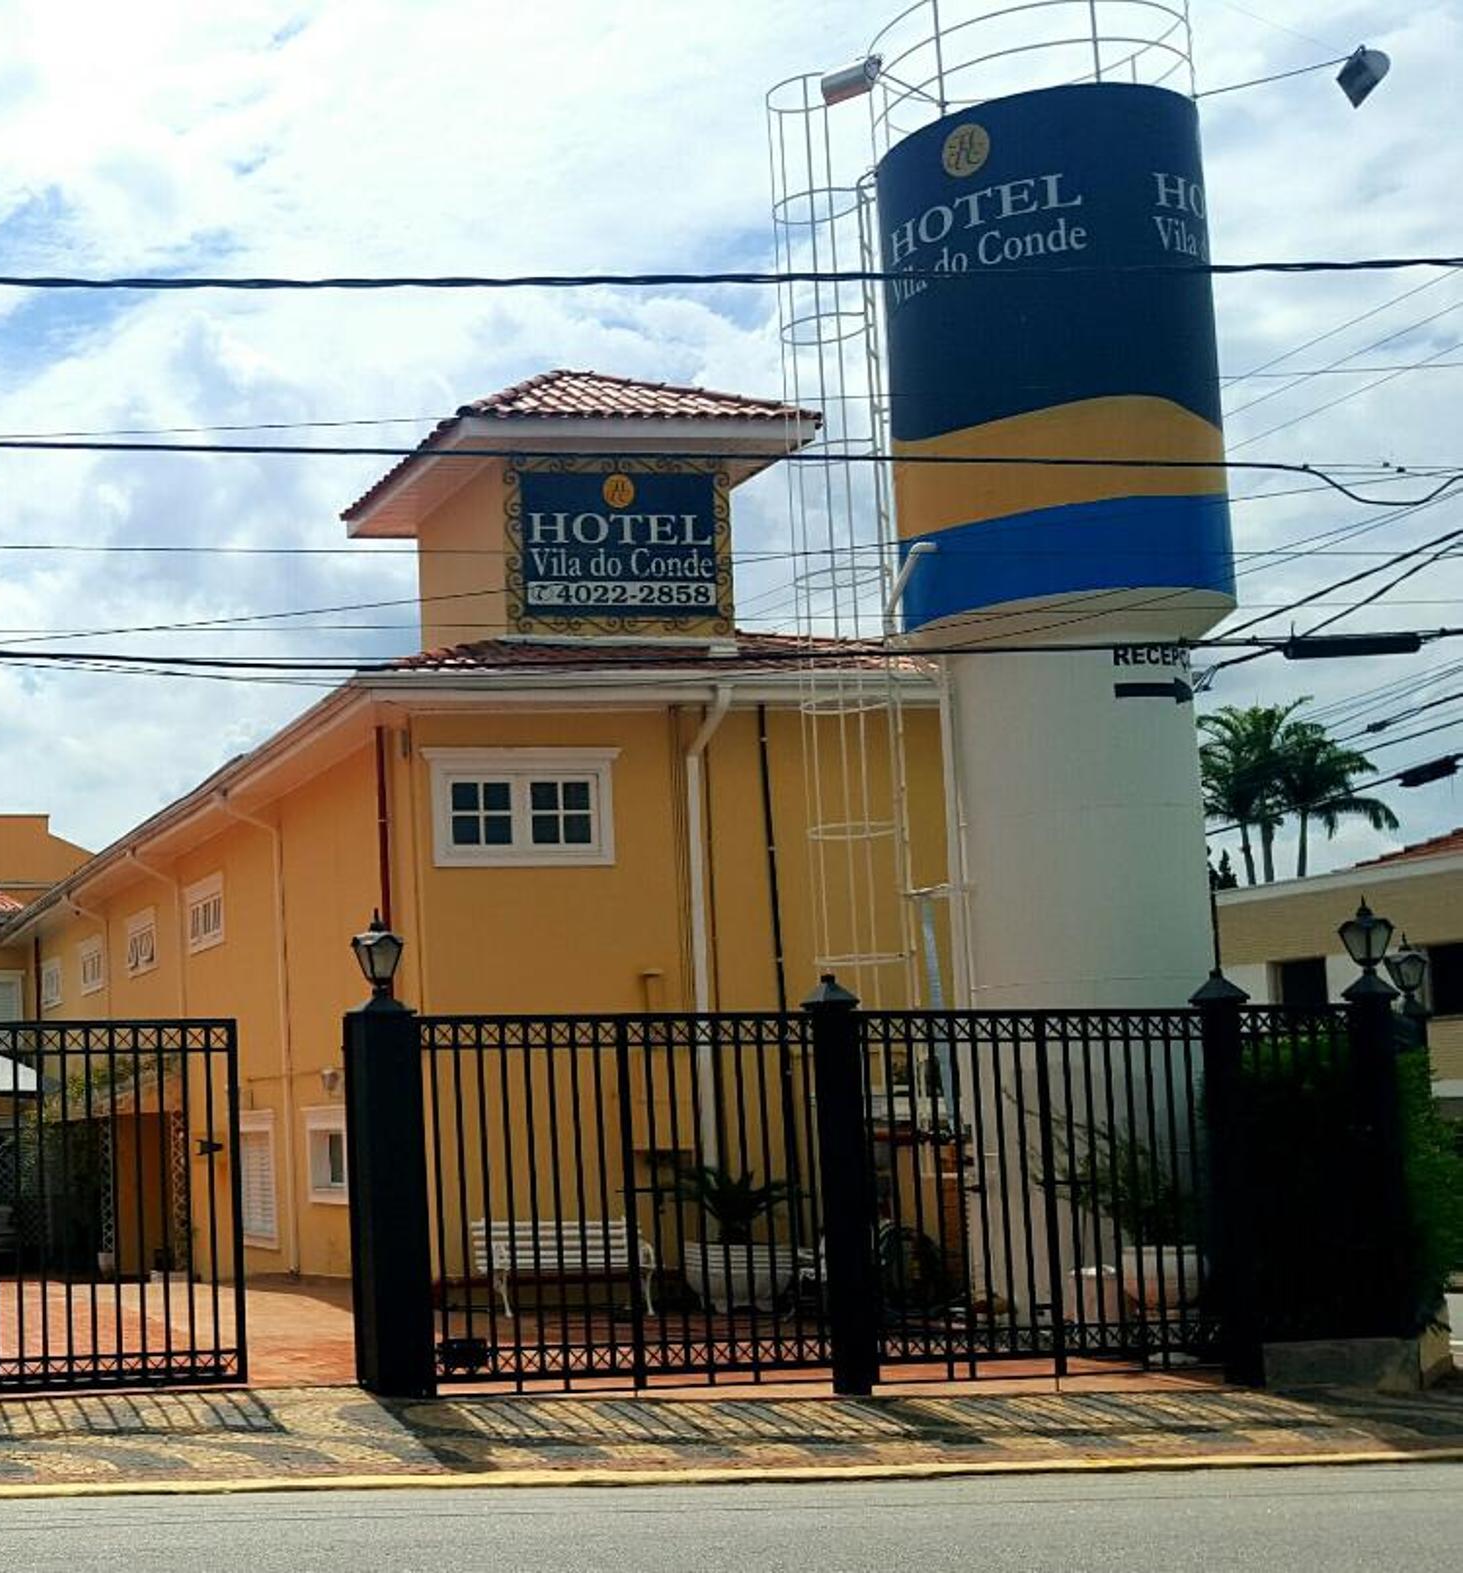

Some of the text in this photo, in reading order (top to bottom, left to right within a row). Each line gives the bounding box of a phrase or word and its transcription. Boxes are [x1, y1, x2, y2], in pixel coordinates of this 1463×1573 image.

[889, 172, 1082, 265] HOTEL
[1152, 215, 1199, 256] Vila
[934, 247, 968, 275] do
[978, 217, 1088, 265] Conde
[527, 512, 713, 546] HOTEL
[529, 548, 715, 578] Vila do Conde
[556, 583, 711, 605] 4022-2858
